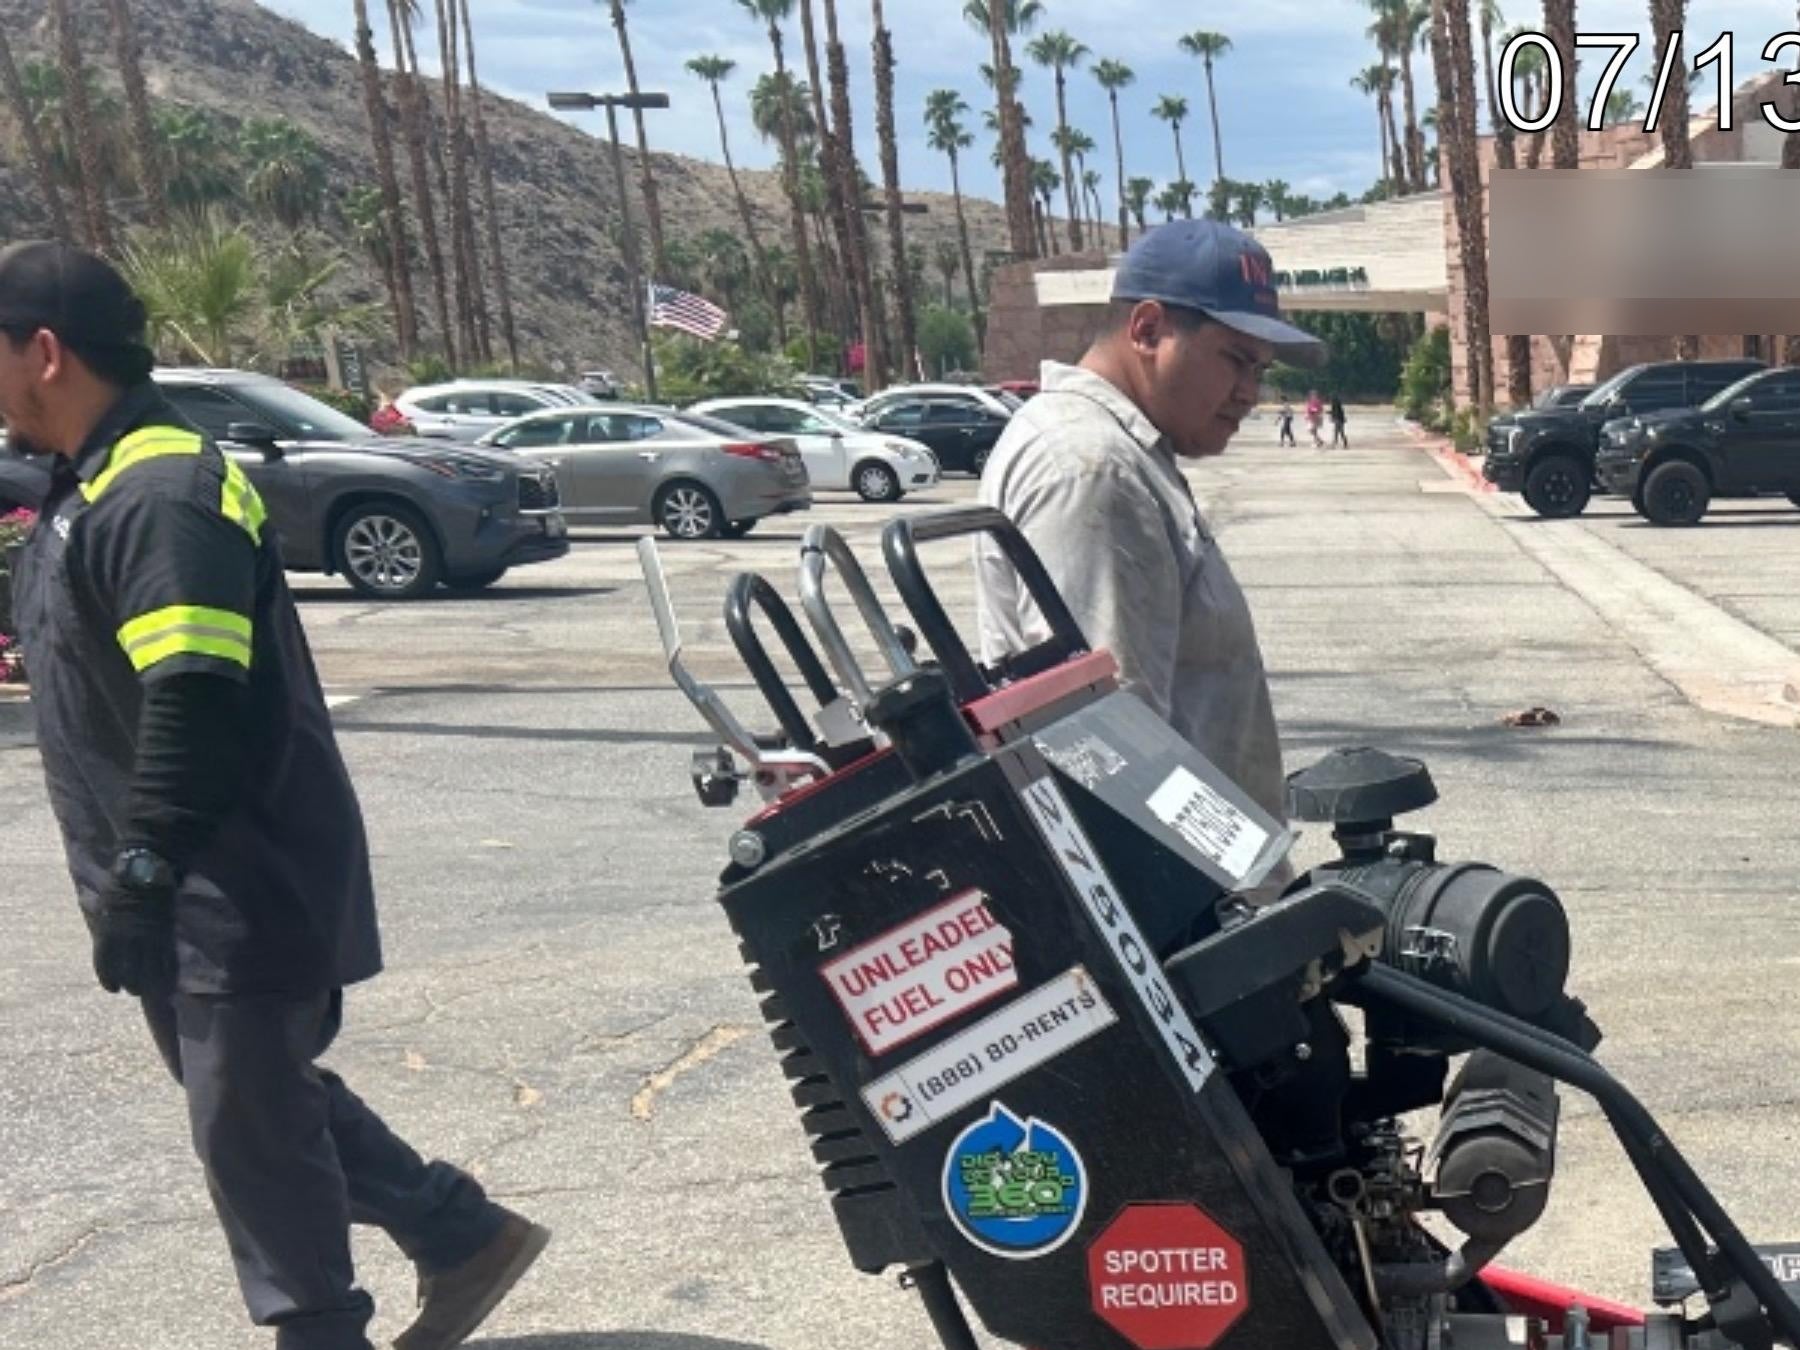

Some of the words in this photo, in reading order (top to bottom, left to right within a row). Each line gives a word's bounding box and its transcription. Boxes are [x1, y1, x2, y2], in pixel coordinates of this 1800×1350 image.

[863, 984, 945, 1035] FUEL
[917, 1054, 985, 1102] (888)
[985, 989, 1096, 1064] 80-RENTS
[1105, 1248, 1227, 1274] SPOTTER
[1102, 1281, 1238, 1308] REQUIRED
